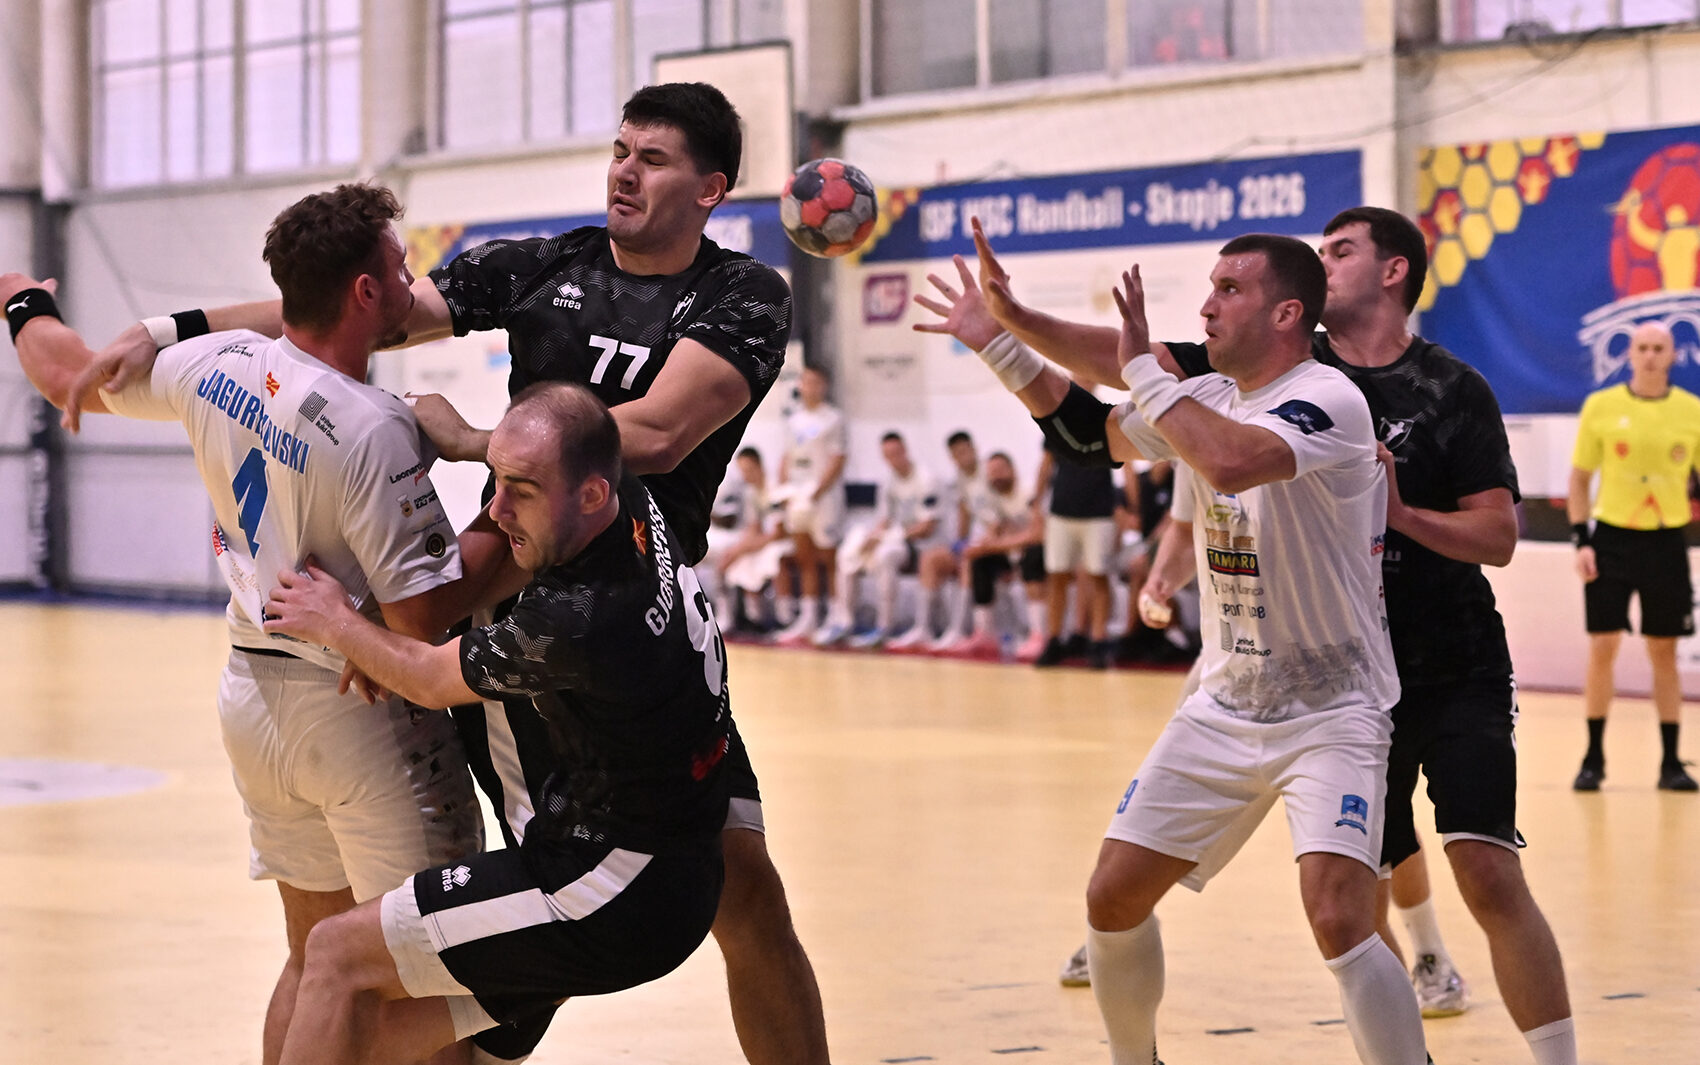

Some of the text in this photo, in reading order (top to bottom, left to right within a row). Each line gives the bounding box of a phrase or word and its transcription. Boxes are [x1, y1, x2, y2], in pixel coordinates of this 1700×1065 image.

[1018, 187, 1123, 234] Handball
[1145, 179, 1234, 231] Skopje
[1239, 172, 1306, 217] 2026
[588, 334, 651, 391] 77
[231, 446, 269, 559] 4
